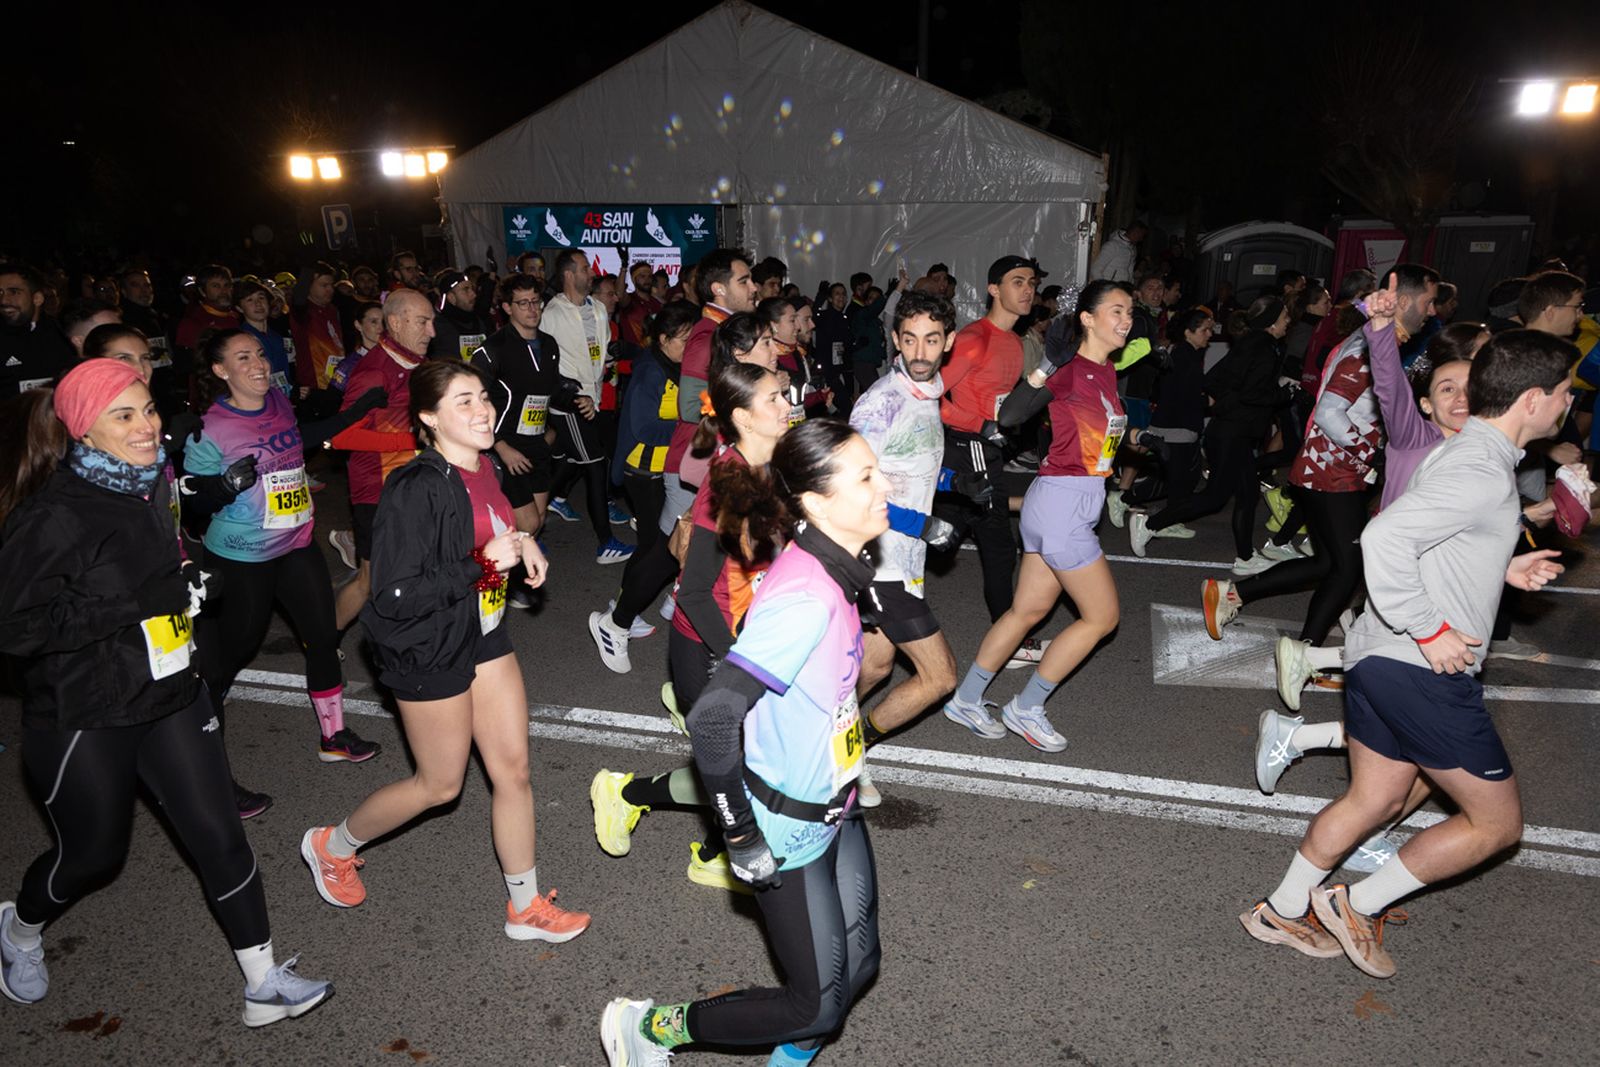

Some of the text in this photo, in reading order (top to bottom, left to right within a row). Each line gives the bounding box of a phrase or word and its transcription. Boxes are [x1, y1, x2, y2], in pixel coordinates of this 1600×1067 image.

[329, 211, 347, 234] P
[584, 211, 634, 228] 43 SAN
[580, 225, 632, 244] ANTÓN
